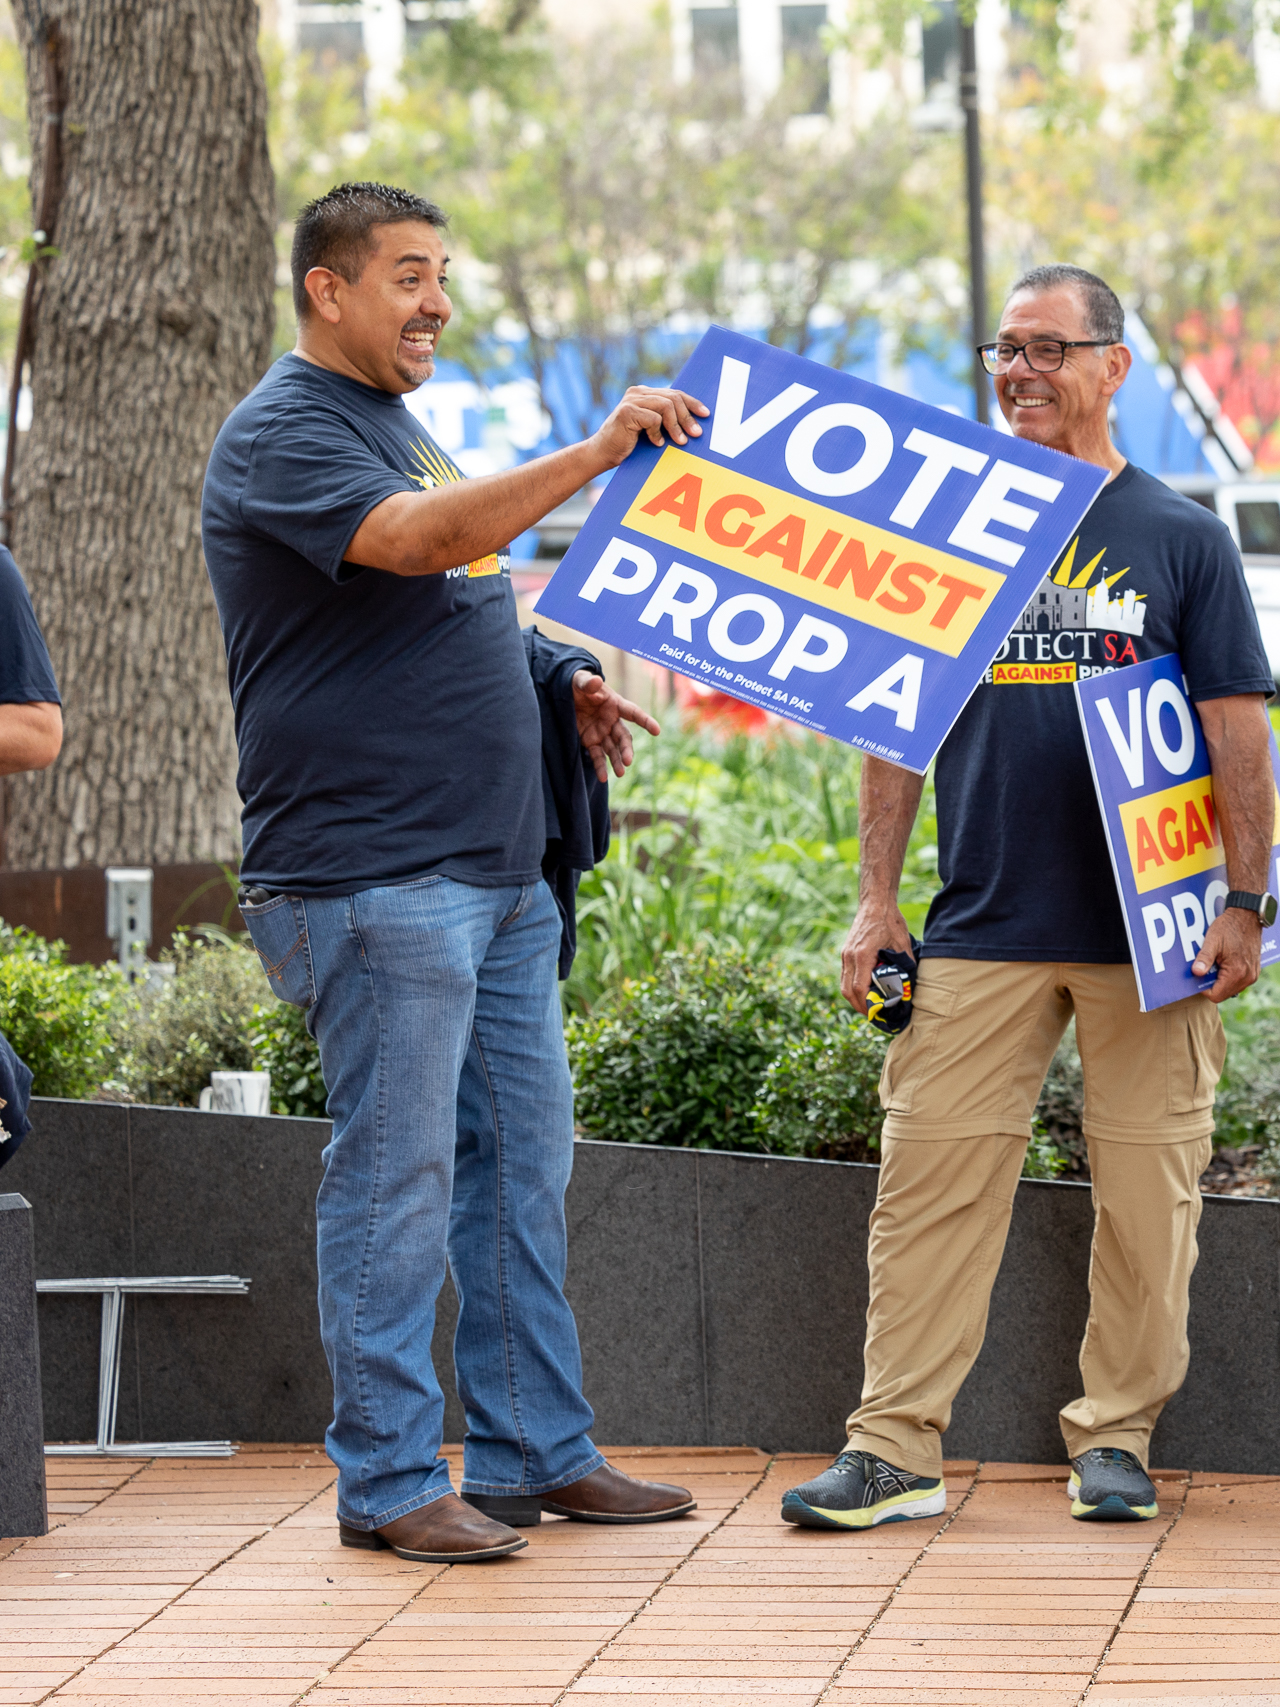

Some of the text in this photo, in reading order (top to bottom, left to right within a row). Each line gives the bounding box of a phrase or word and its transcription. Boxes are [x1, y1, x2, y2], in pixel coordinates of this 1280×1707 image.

[709, 355, 1064, 567] VOTE
[639, 473, 986, 630] AGAINST
[578, 537, 924, 732] PROP A
[659, 643, 685, 660] Paid
[683, 653, 701, 667] for
[699, 660, 715, 674] by
[715, 665, 734, 681] the
[734, 673, 774, 697] Protect
[772, 690, 788, 704] SA
[789, 696, 814, 713] PAC
[995, 666, 1073, 681] AGAINST
[1104, 633, 1139, 664] SA
[1095, 678, 1196, 788] VO
[1136, 794, 1220, 874] AGAI
